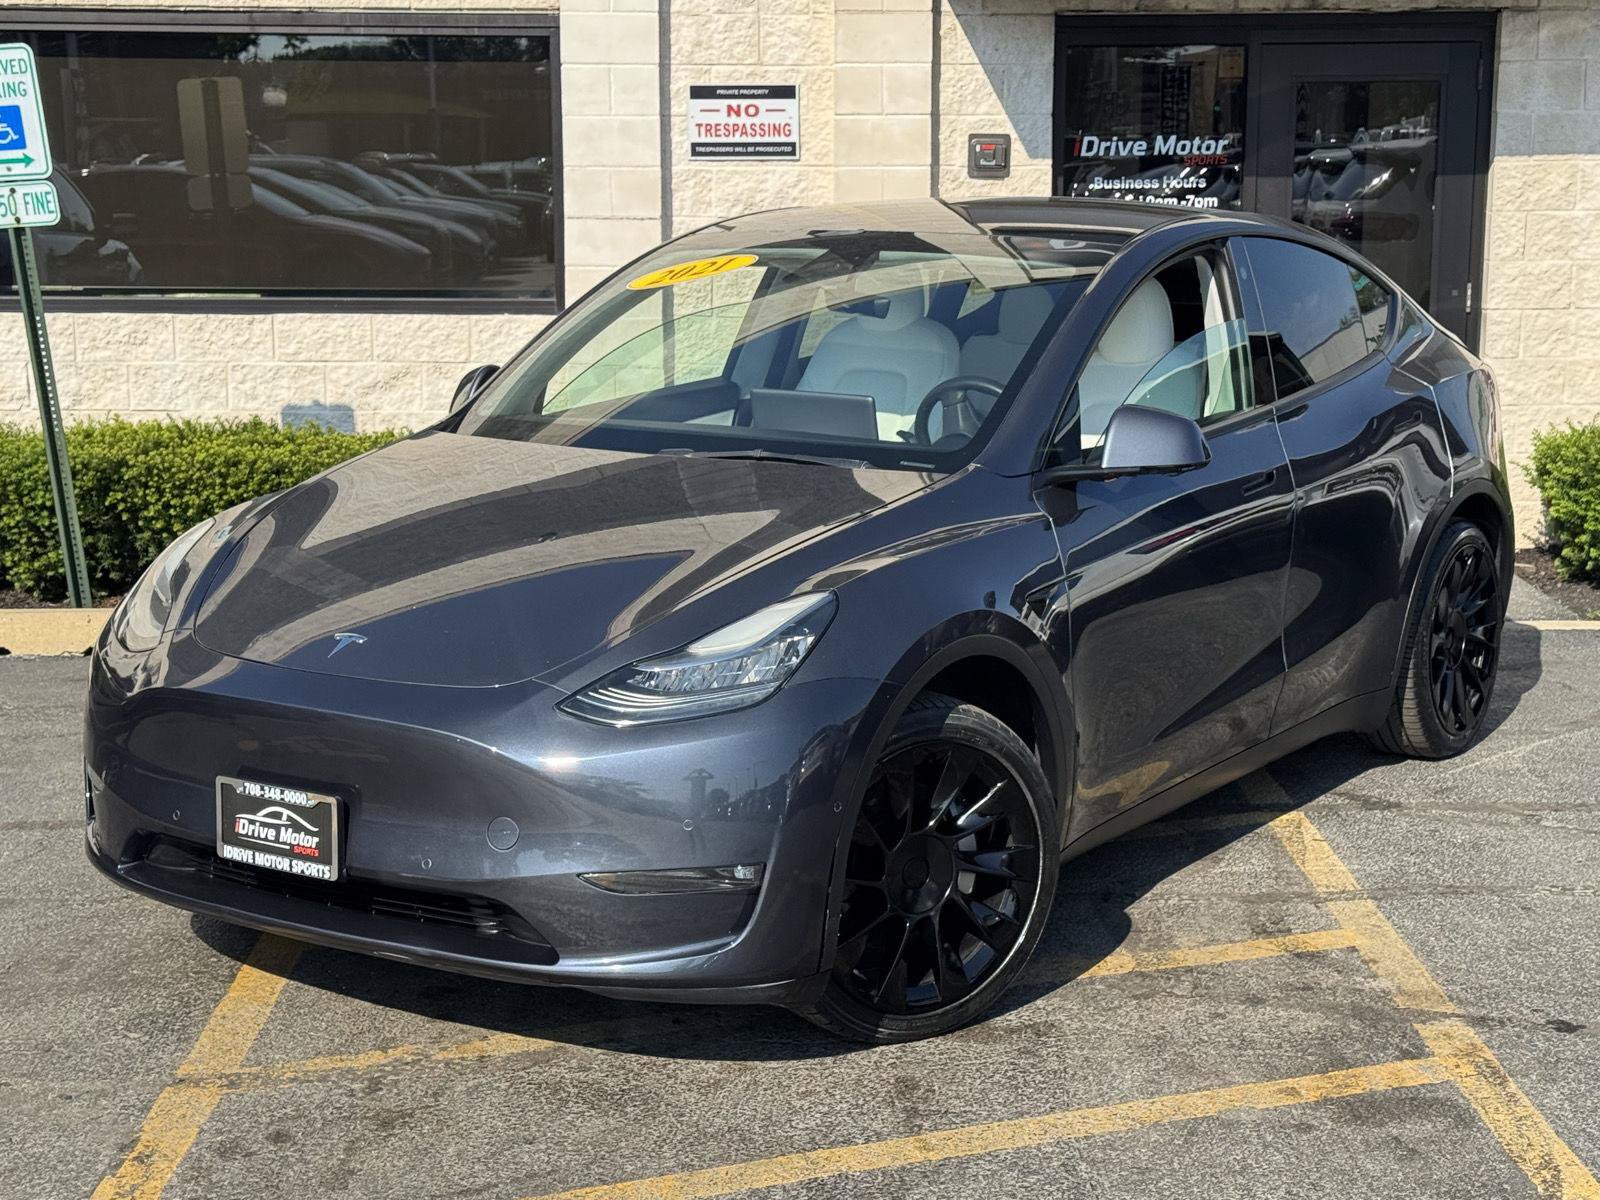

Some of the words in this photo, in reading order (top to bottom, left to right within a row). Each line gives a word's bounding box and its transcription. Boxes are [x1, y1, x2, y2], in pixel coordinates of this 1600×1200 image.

[0, 58, 28, 75] VED
[0, 80, 27, 98] ING
[726, 103, 760, 118] NO
[695, 122, 792, 138] TRESPASSING
[1072, 135, 1147, 157] iDrive
[1153, 134, 1229, 157] Motor
[1183, 155, 1229, 166] SPORTS
[1093, 176, 1160, 190] Business
[1162, 175, 1207, 189] Hours
[22, 191, 54, 216] FINE
[645, 256, 738, 286] 2021
[244, 782, 307, 806] 708-348-0000
[234, 817, 276, 841] iDrive
[279, 826, 319, 848] Motor
[292, 845, 319, 857] SPORTS
[223, 844, 254, 864] IDRIVE
[254, 851, 291, 873] MOTOR
[291, 861, 331, 880] SPORTS
